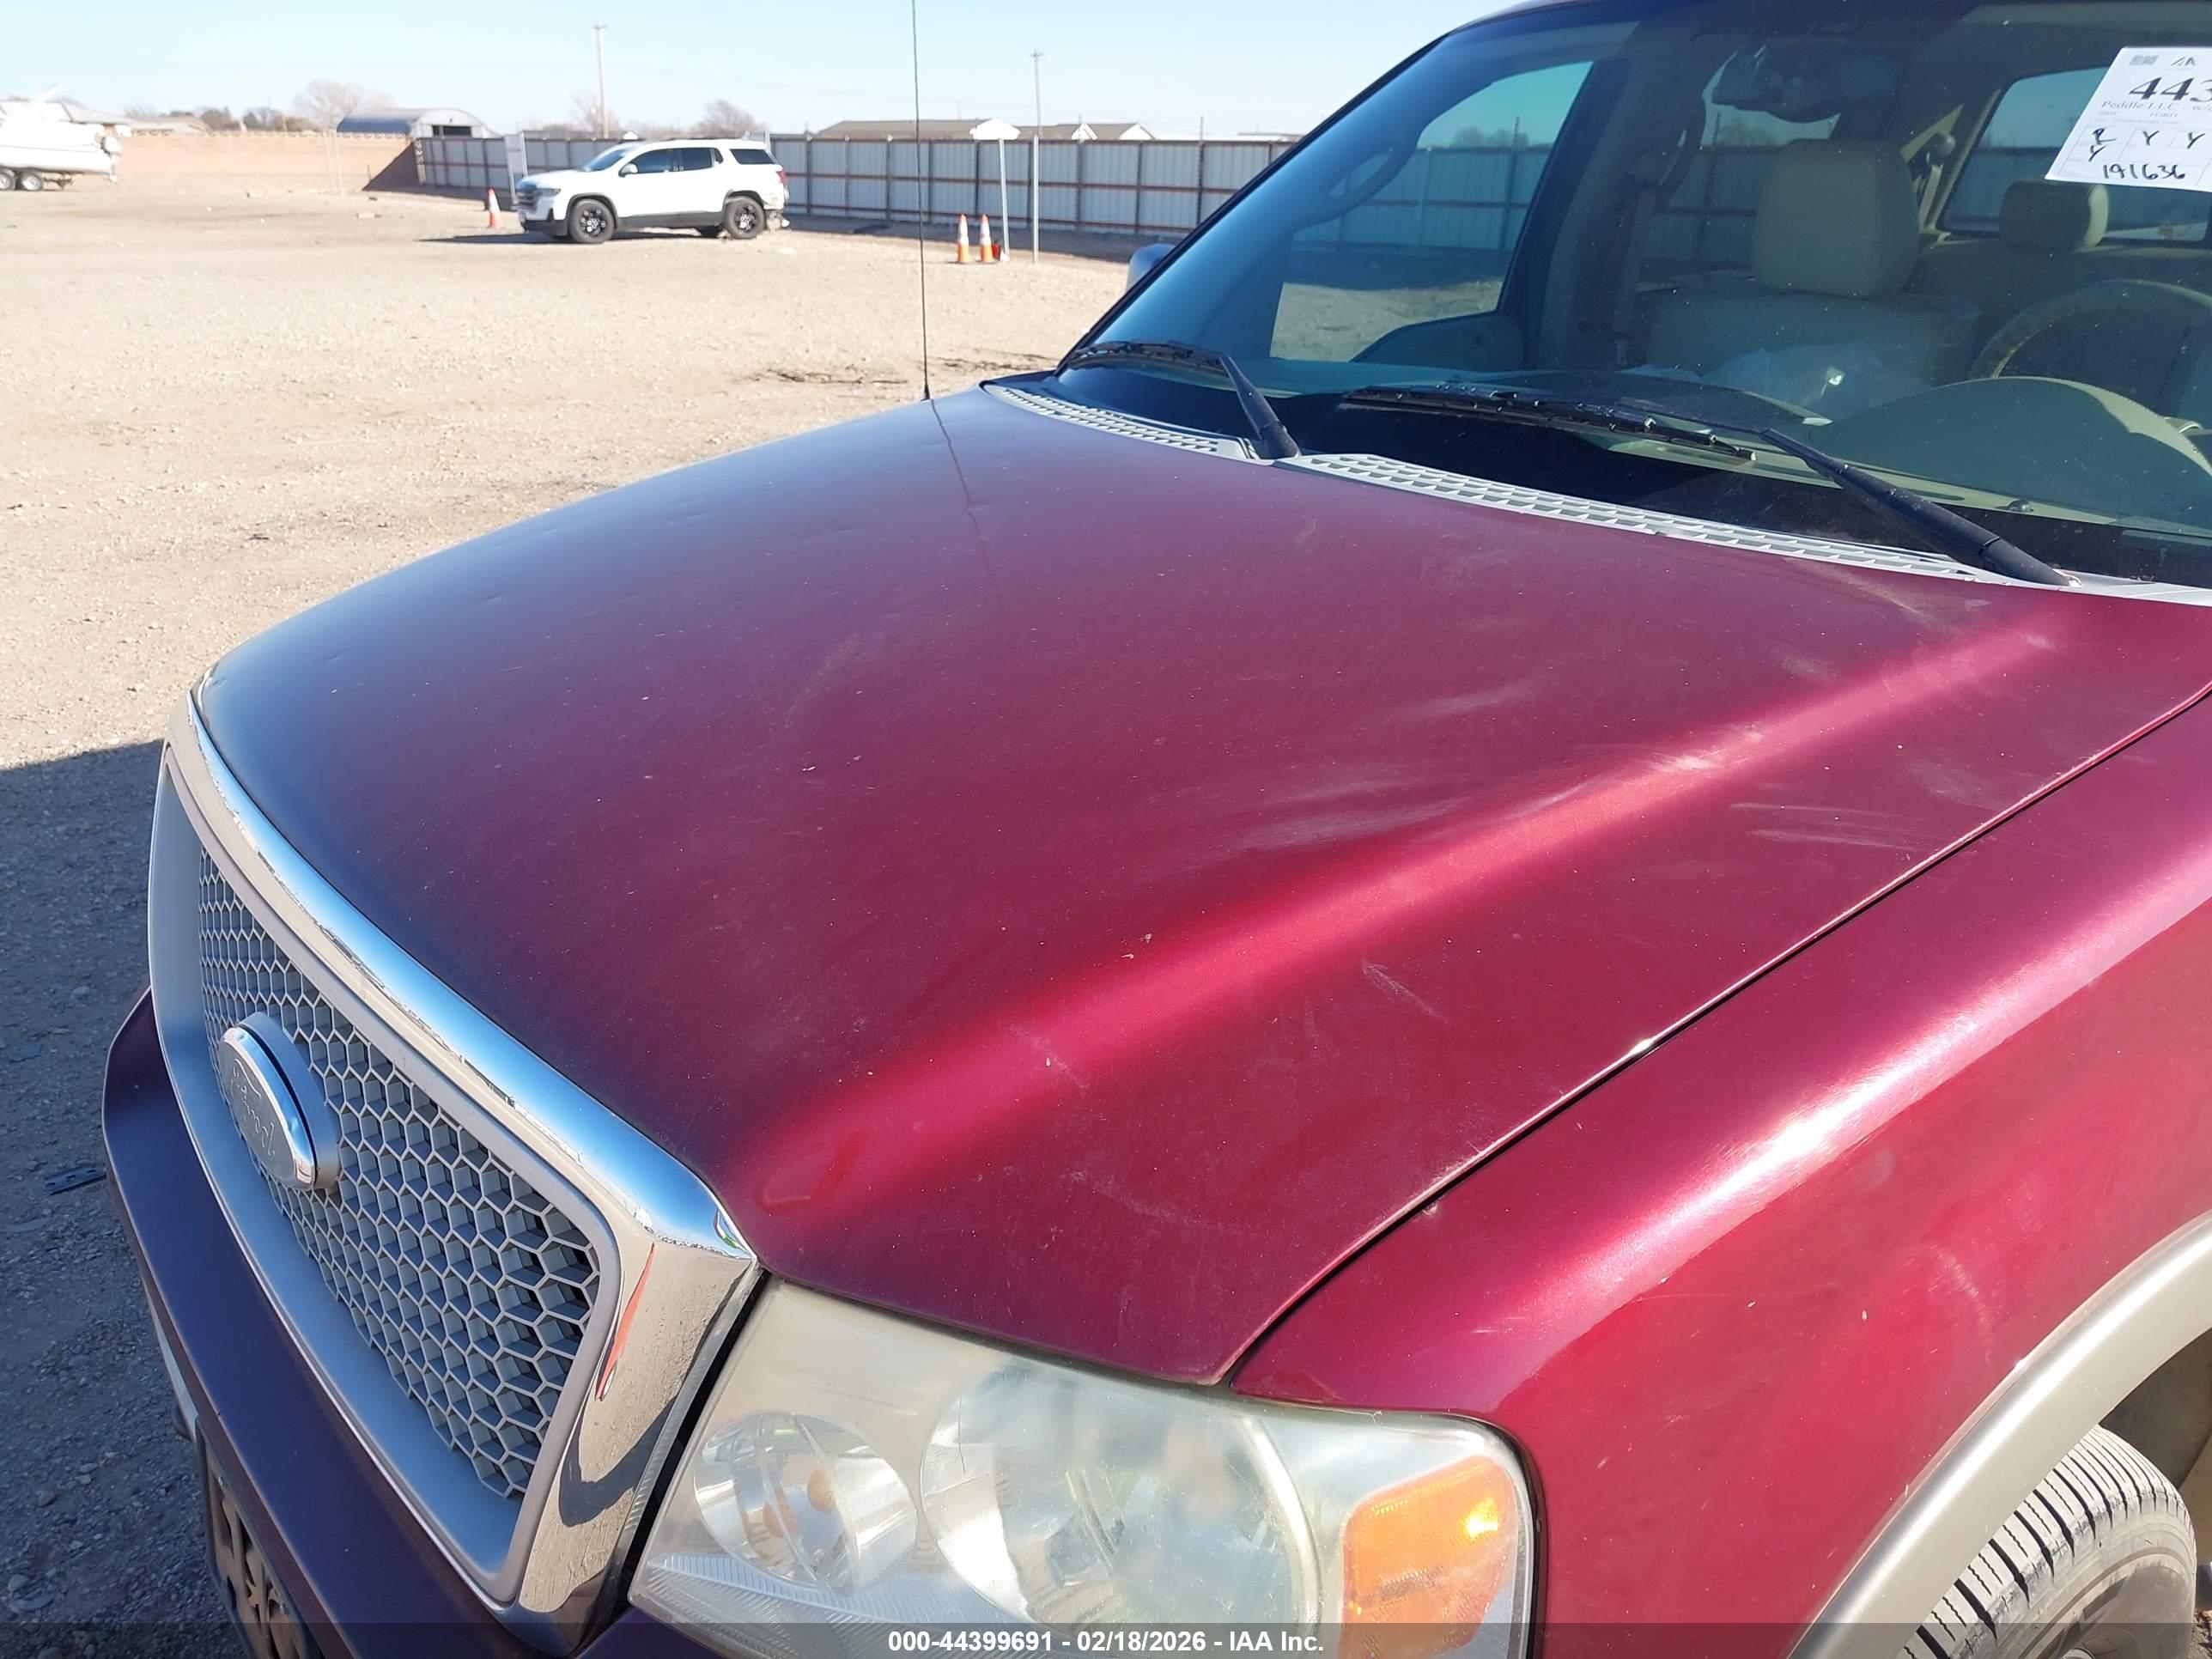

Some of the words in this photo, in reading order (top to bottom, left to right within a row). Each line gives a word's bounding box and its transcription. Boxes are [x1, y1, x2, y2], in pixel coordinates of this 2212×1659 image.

[2101, 100, 2144, 110] Peddle
[2142, 130, 2160, 146] Y
[2186, 132, 2206, 149] Y
[2102, 163, 2186, 179] 191636
